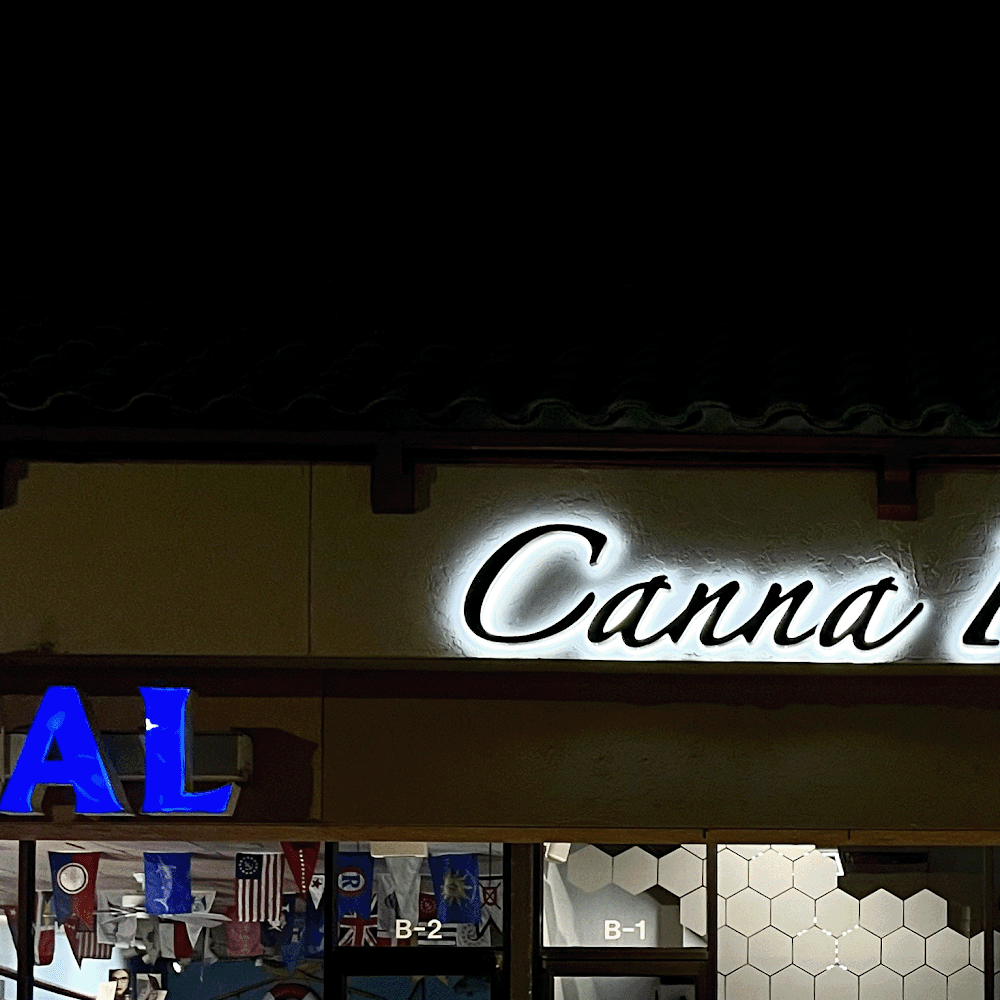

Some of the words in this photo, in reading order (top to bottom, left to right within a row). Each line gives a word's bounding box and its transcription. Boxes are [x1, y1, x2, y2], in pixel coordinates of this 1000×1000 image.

[461, 523, 924, 652] Canna
[395, 919, 443, 939] B-2
[604, 919, 646, 940] B-1
